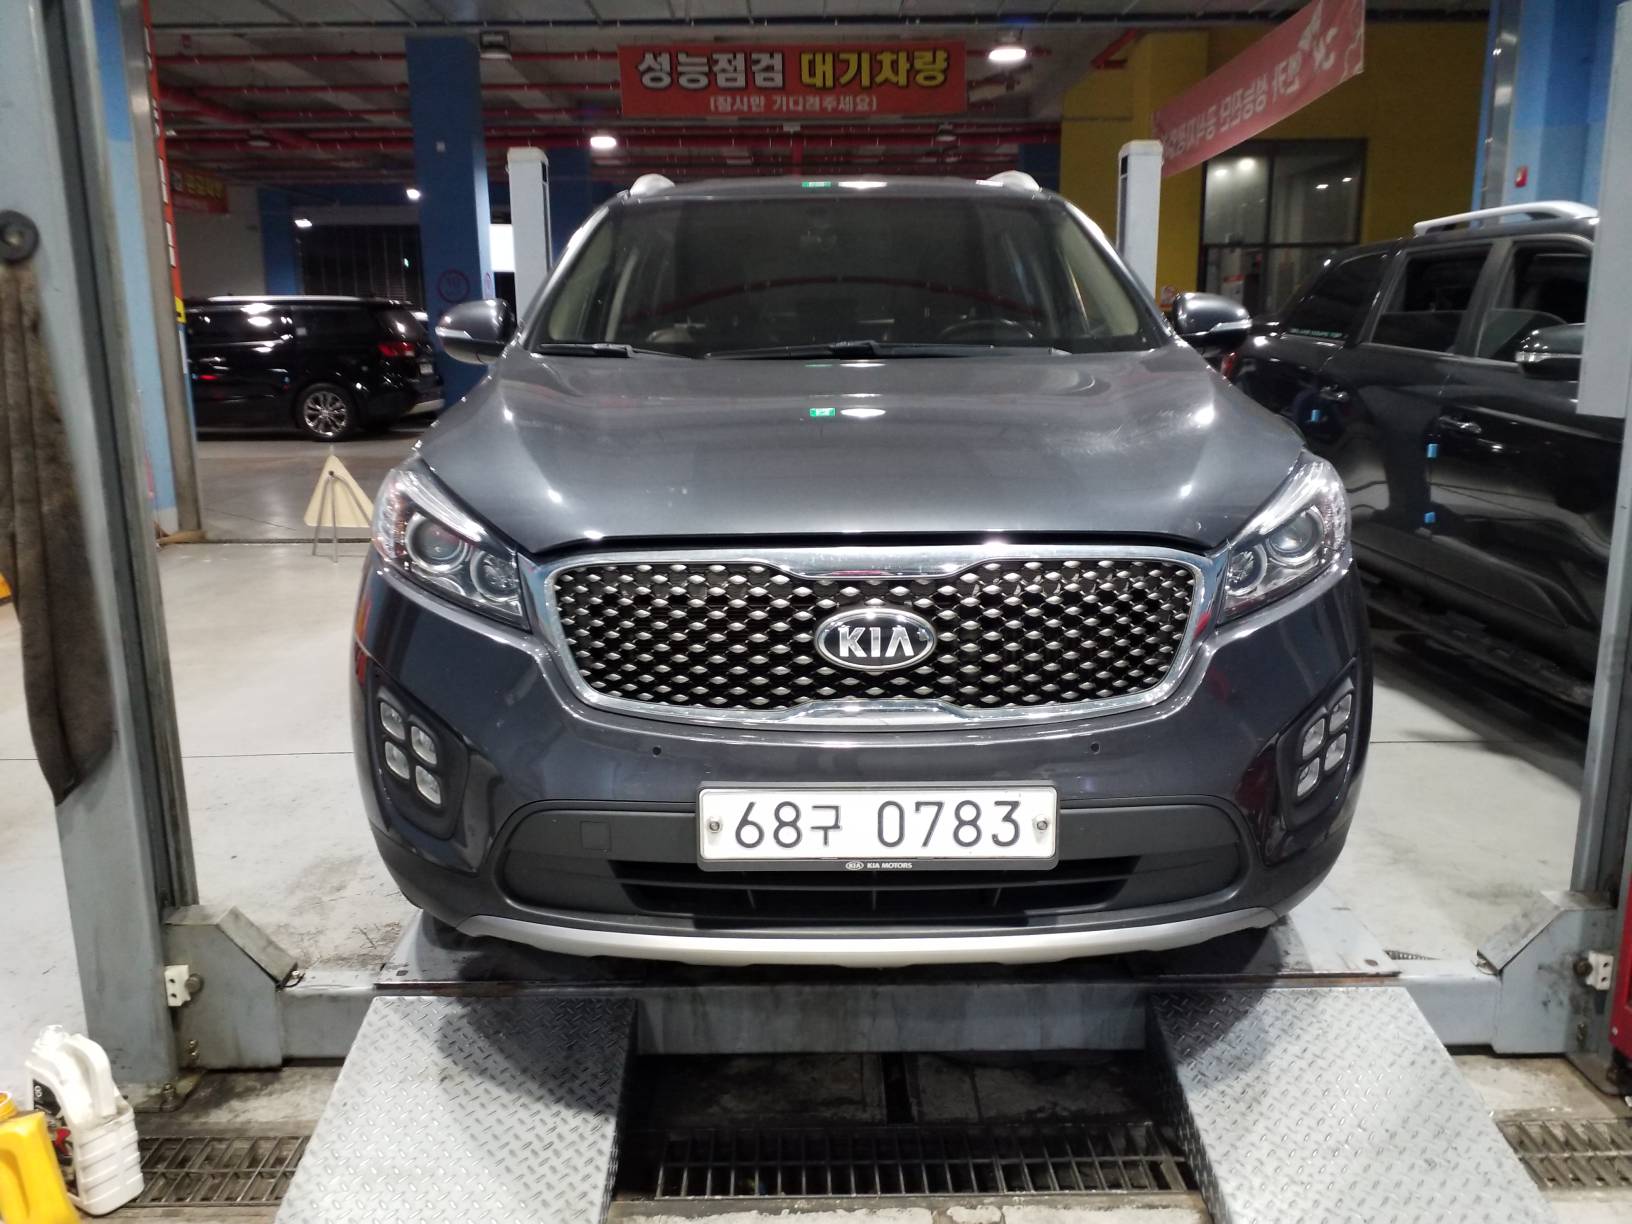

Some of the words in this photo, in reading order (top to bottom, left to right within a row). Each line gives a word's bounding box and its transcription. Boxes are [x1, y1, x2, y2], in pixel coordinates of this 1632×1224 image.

[638, 51, 783, 88] 성능점검
[800, 50, 948, 88] 대기차량
[838, 626, 914, 657] KIA
[735, 801, 842, 848] 68구
[877, 800, 1020, 847] 0783
